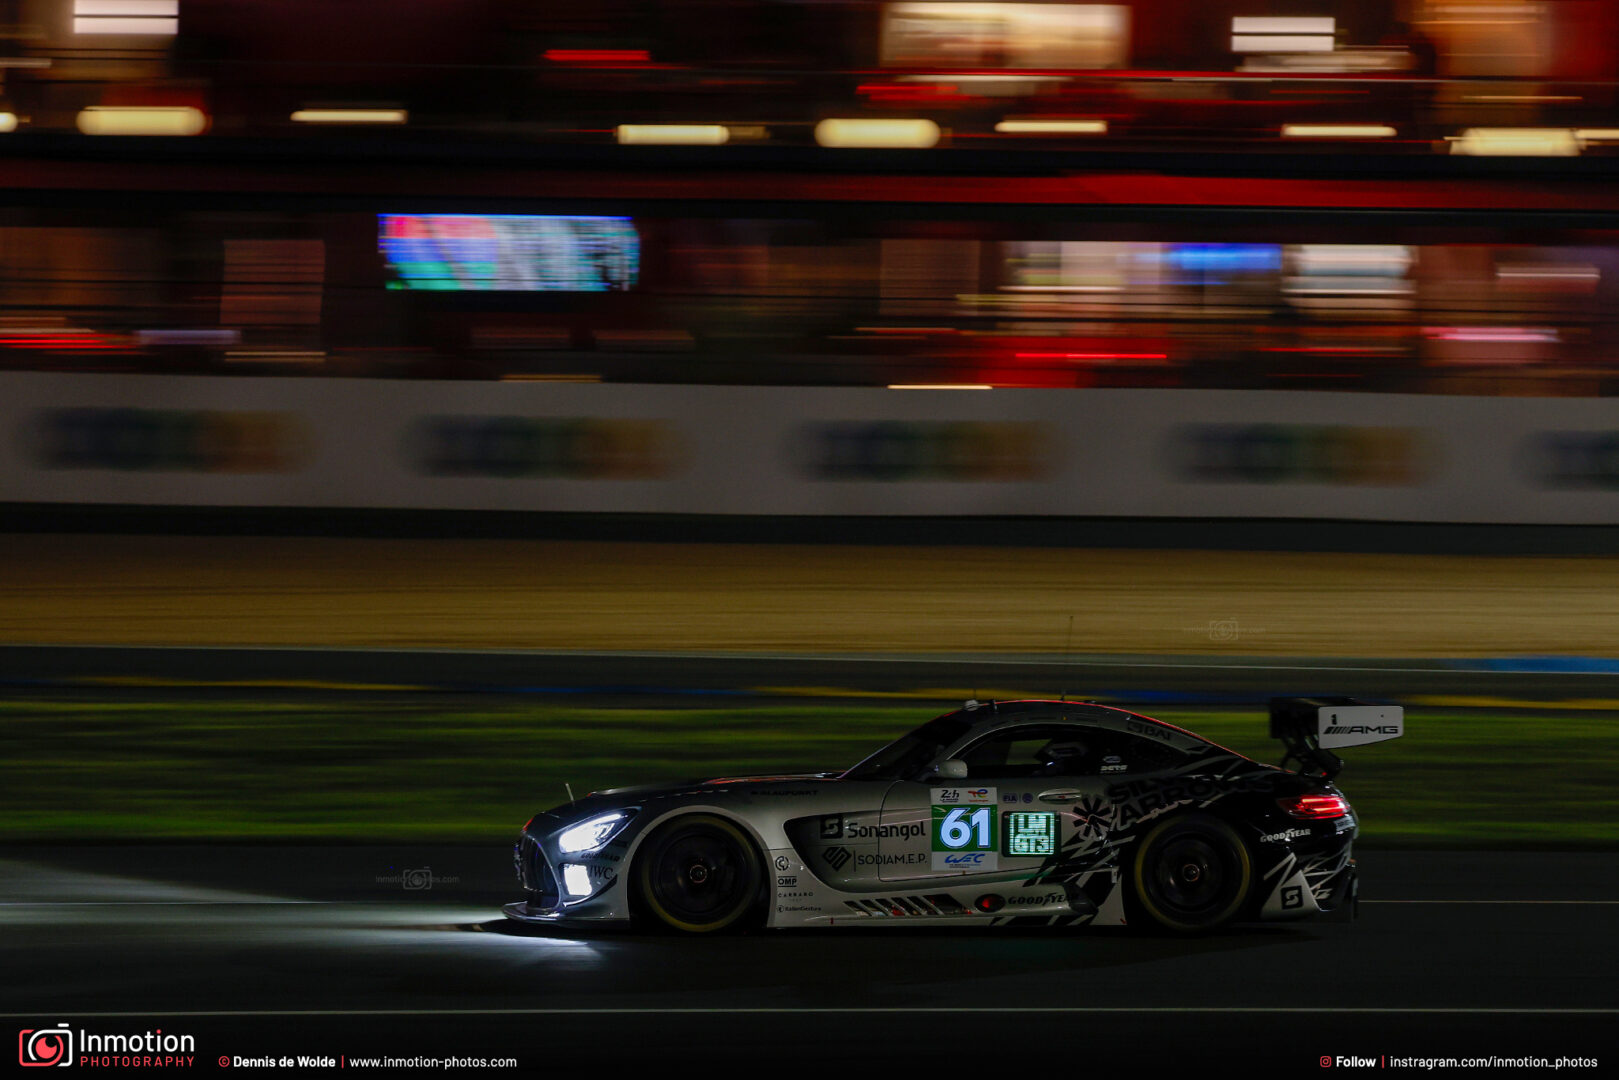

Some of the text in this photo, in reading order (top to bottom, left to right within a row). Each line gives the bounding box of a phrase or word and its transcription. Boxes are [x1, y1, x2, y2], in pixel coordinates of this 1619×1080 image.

[1348, 726, 1398, 734] AMG
[848, 821, 926, 841] Sonangol
[941, 808, 991, 848] 61
[1260, 828, 1311, 842] GOODYEAR
[945, 853, 986, 864] WEC
